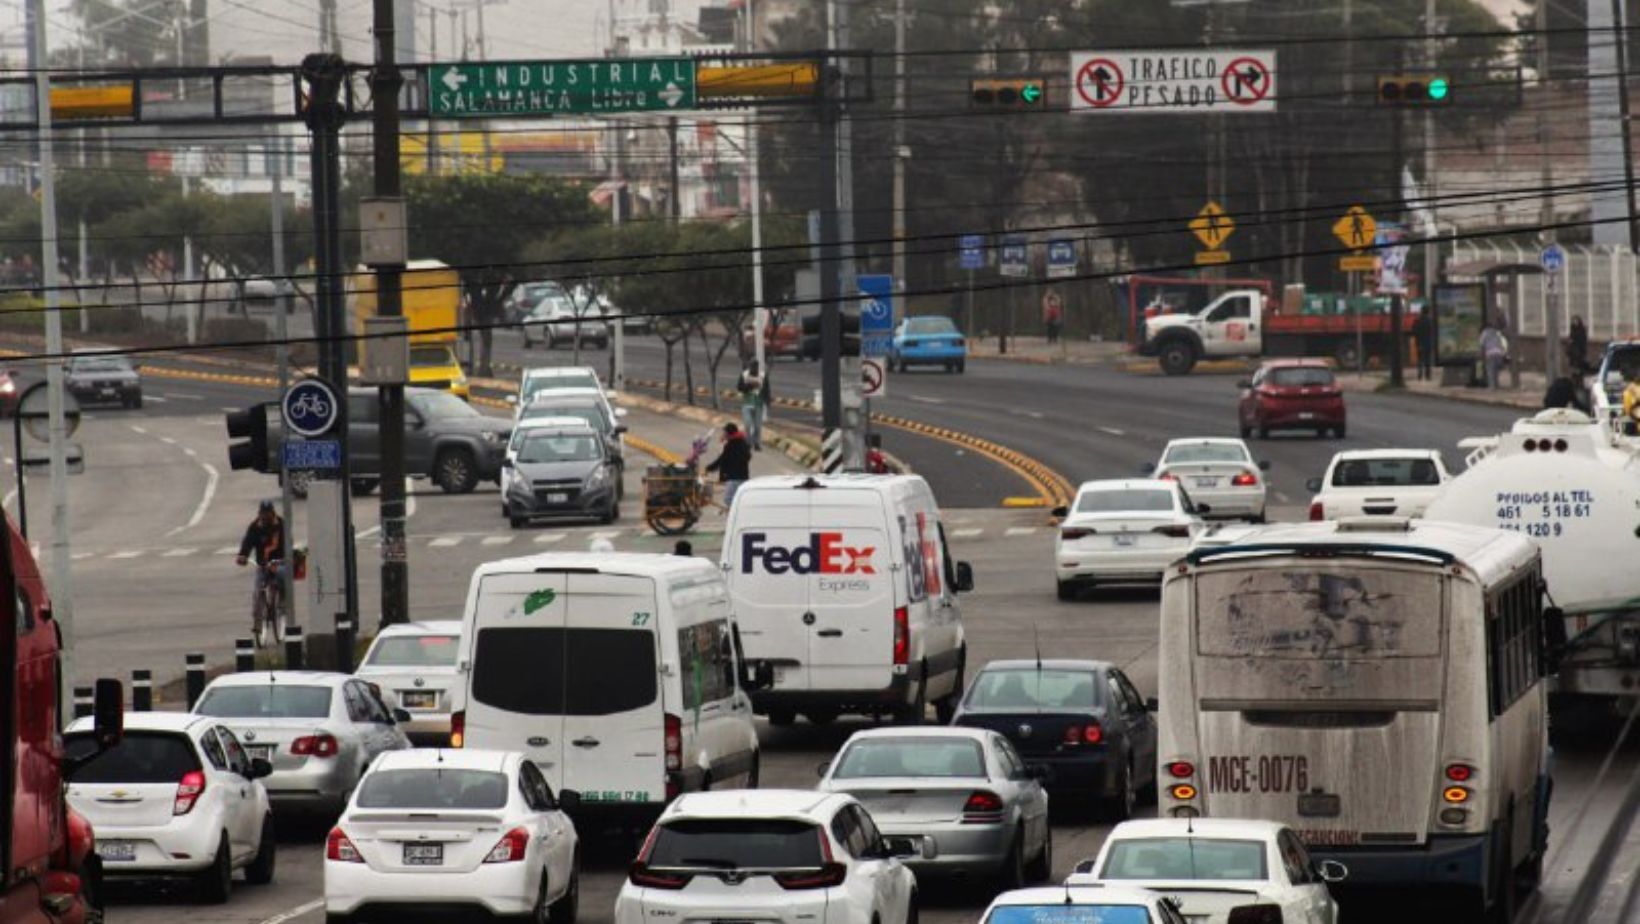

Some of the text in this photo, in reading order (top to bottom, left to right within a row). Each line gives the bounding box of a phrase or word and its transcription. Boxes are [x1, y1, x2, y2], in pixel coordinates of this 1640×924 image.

[479, 62, 686, 87] INDUSTRIAL
[1130, 56, 1217, 80] TRAFICO
[440, 88, 571, 113] SALAMANCA
[1128, 84, 1216, 106] PESADO
[1552, 491, 1568, 503] AL
[1570, 489, 1593, 502] TEL
[1497, 505, 1520, 519] 461
[741, 532, 876, 575] FedEx
[819, 578, 871, 594] Express
[632, 612, 650, 626] 27
[1209, 754, 1309, 794] MCE-0076
